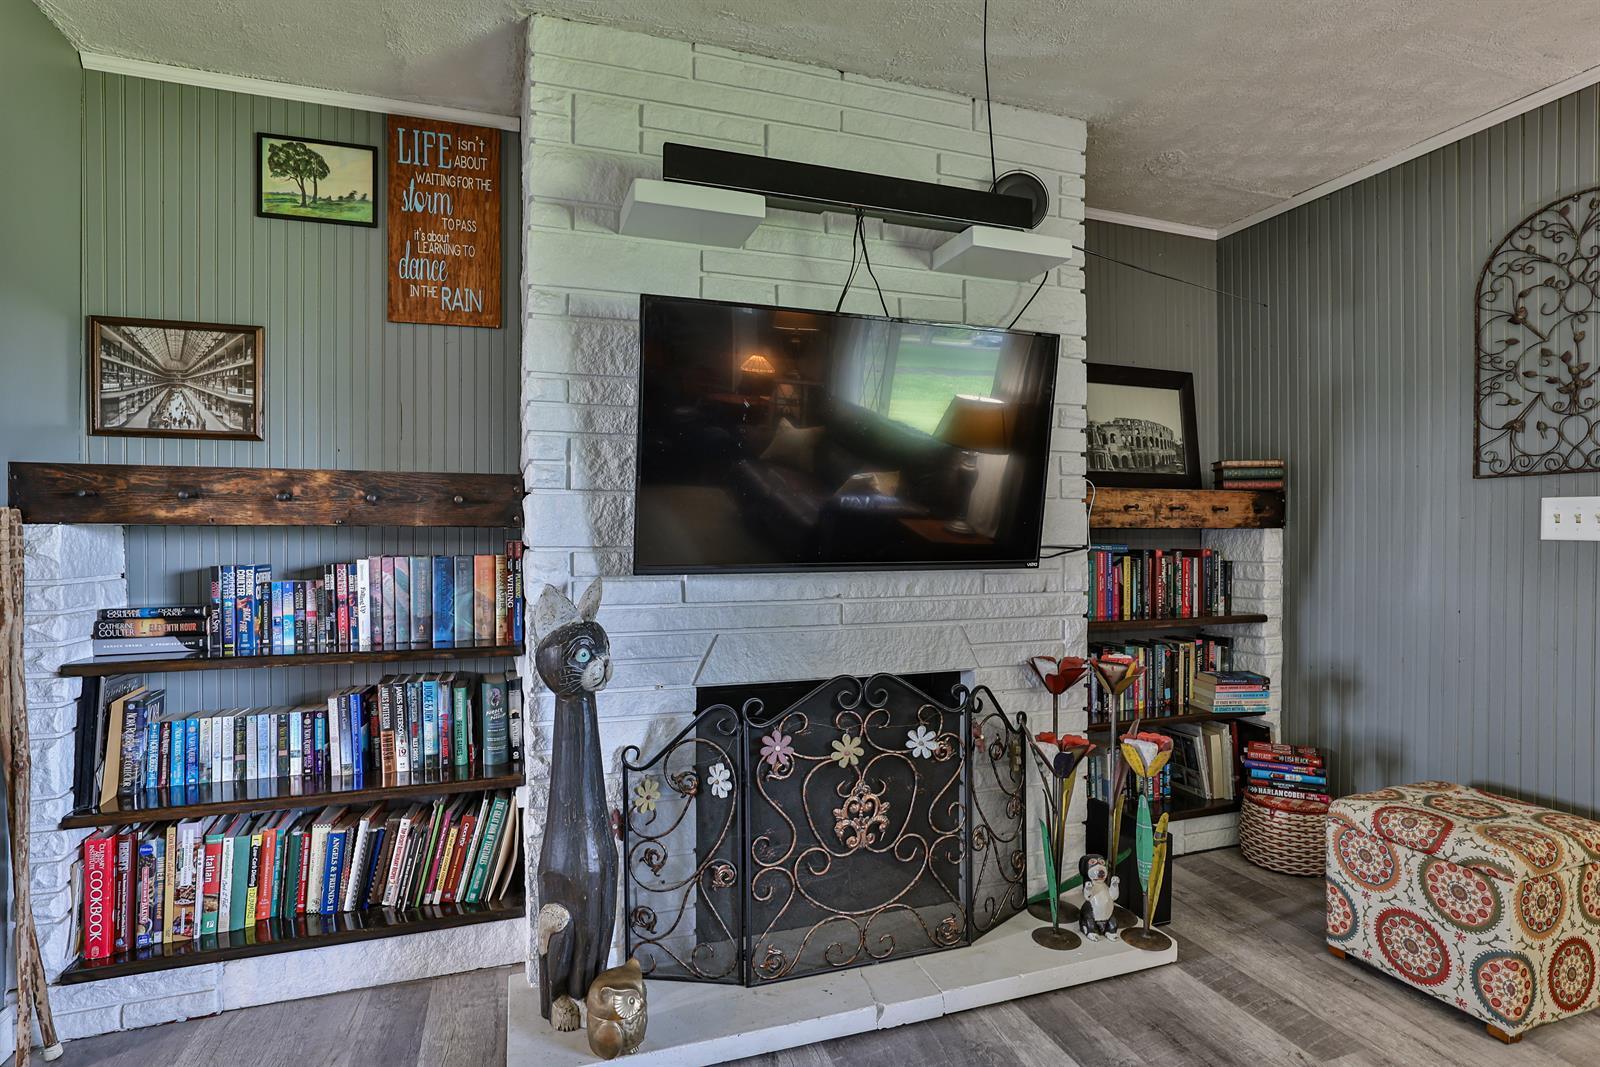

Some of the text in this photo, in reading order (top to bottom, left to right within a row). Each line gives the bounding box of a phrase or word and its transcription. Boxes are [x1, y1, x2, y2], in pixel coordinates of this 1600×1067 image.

[398, 128, 485, 169] LIFE isn't
[454, 155, 488, 172] ABOUT
[415, 171, 492, 192] WAITING FOR THE
[401, 178, 454, 216] storm
[413, 227, 450, 243] it's about
[442, 218, 477, 233] TO PASS
[417, 241, 475, 258] LEARNING TO
[398, 240, 448, 282] dance
[410, 284, 482, 312] IN THE RAIN
[236, 569, 245, 597] COULTER
[246, 569, 254, 596] CATHERINE
[149, 623, 197, 632] ELEVENTH HOUR
[394, 686, 403, 704] JAMES
[424, 685, 433, 704] JUDGE
[126, 712, 137, 726] NORA
[381, 687, 390, 729] JAMES PATTERSON
[425, 710, 433, 723] JURY
[382, 734, 393, 760] AMBUSH
[1258, 788, 1305, 800] HARLAN COBEN
[492, 810, 502, 823] GREAT
[496, 801, 505, 810] THE
[118, 842, 130, 871] HERSHEY'S
[331, 837, 340, 865] ANGELS
[479, 840, 492, 865] VEGETABLES
[157, 857, 165, 881] DINNER
[205, 855, 216, 882] italian
[249, 870, 257, 886] Dieting
[328, 874, 336, 904] FRIENDS
[90, 870, 103, 942] COOKBOOK
[139, 902, 148, 923] BAKING
